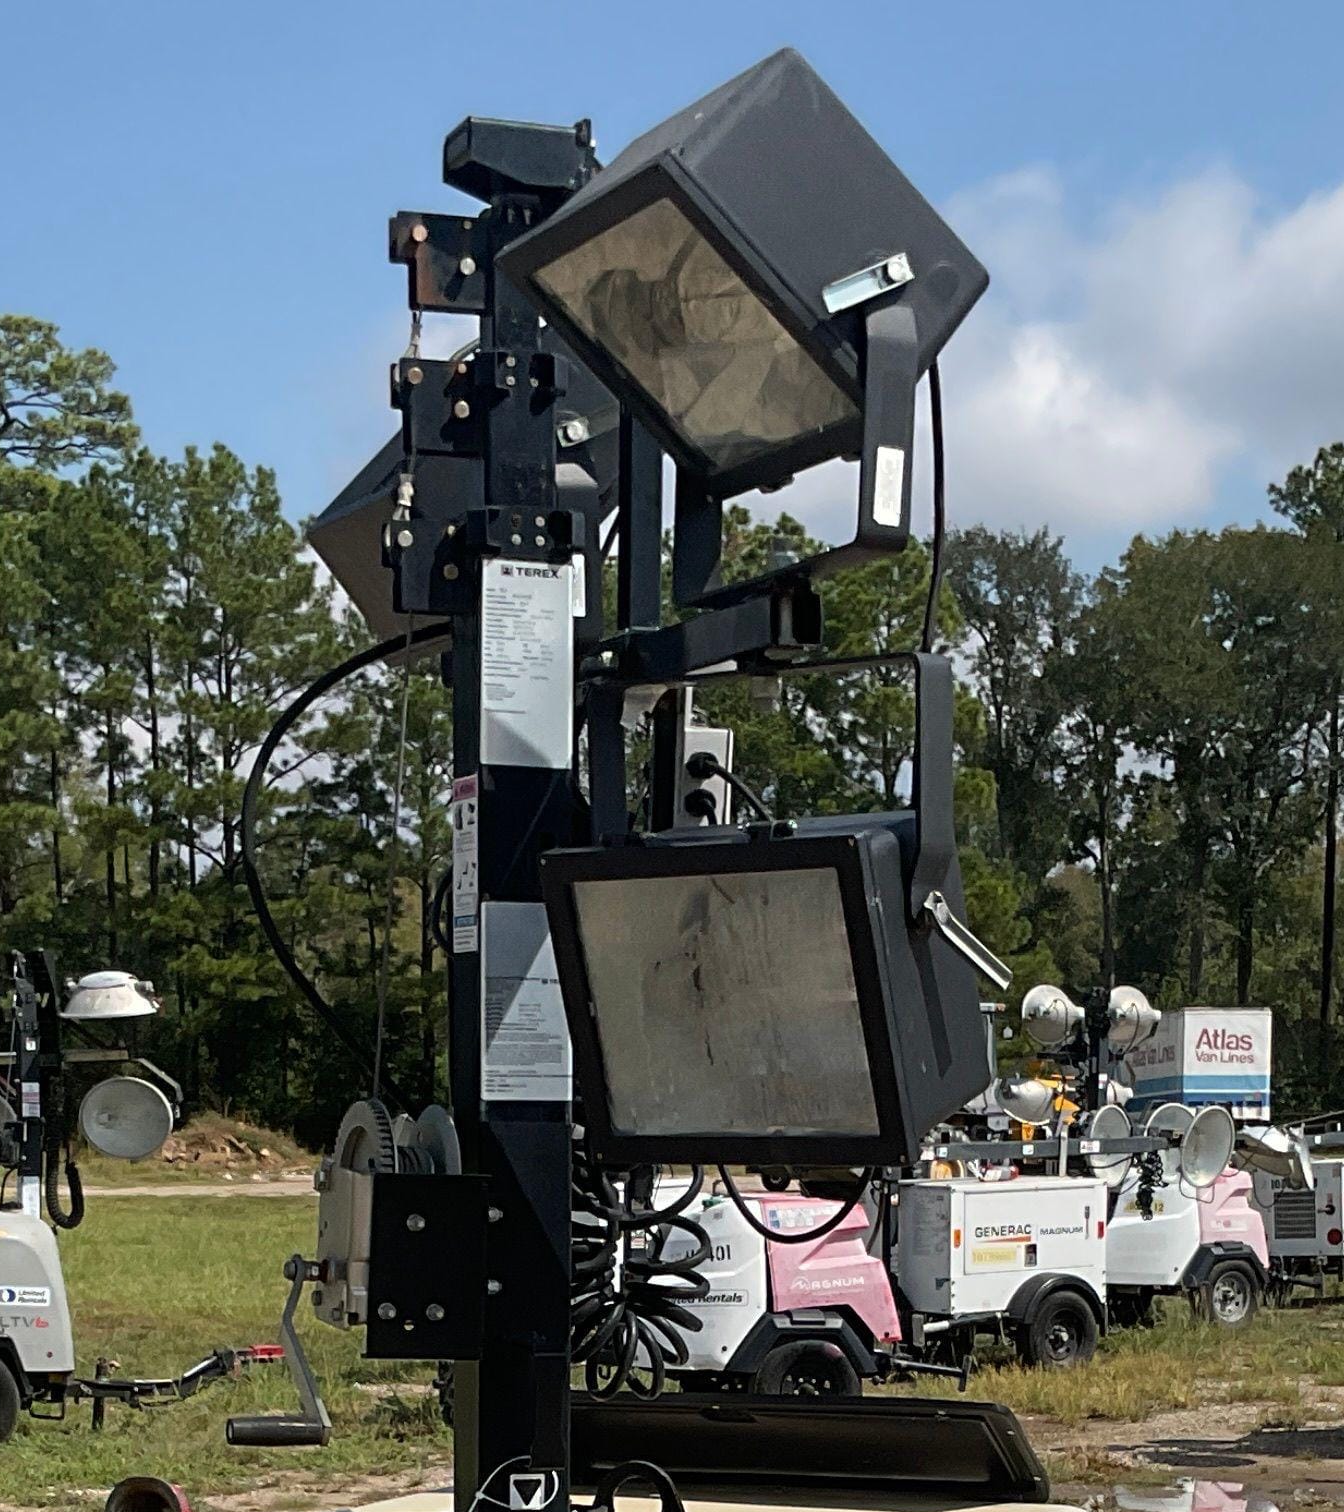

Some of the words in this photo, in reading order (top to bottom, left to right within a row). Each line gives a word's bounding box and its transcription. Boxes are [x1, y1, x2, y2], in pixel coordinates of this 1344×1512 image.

[515, 567, 560, 579] TEREX
[1196, 1028, 1253, 1051] Atlas
[1196, 1050, 1217, 1063] Van
[1220, 1050, 1255, 1064] Lines
[975, 1224, 1032, 1238] GENERAC
[1039, 1226, 1083, 1236] MAGNUM
